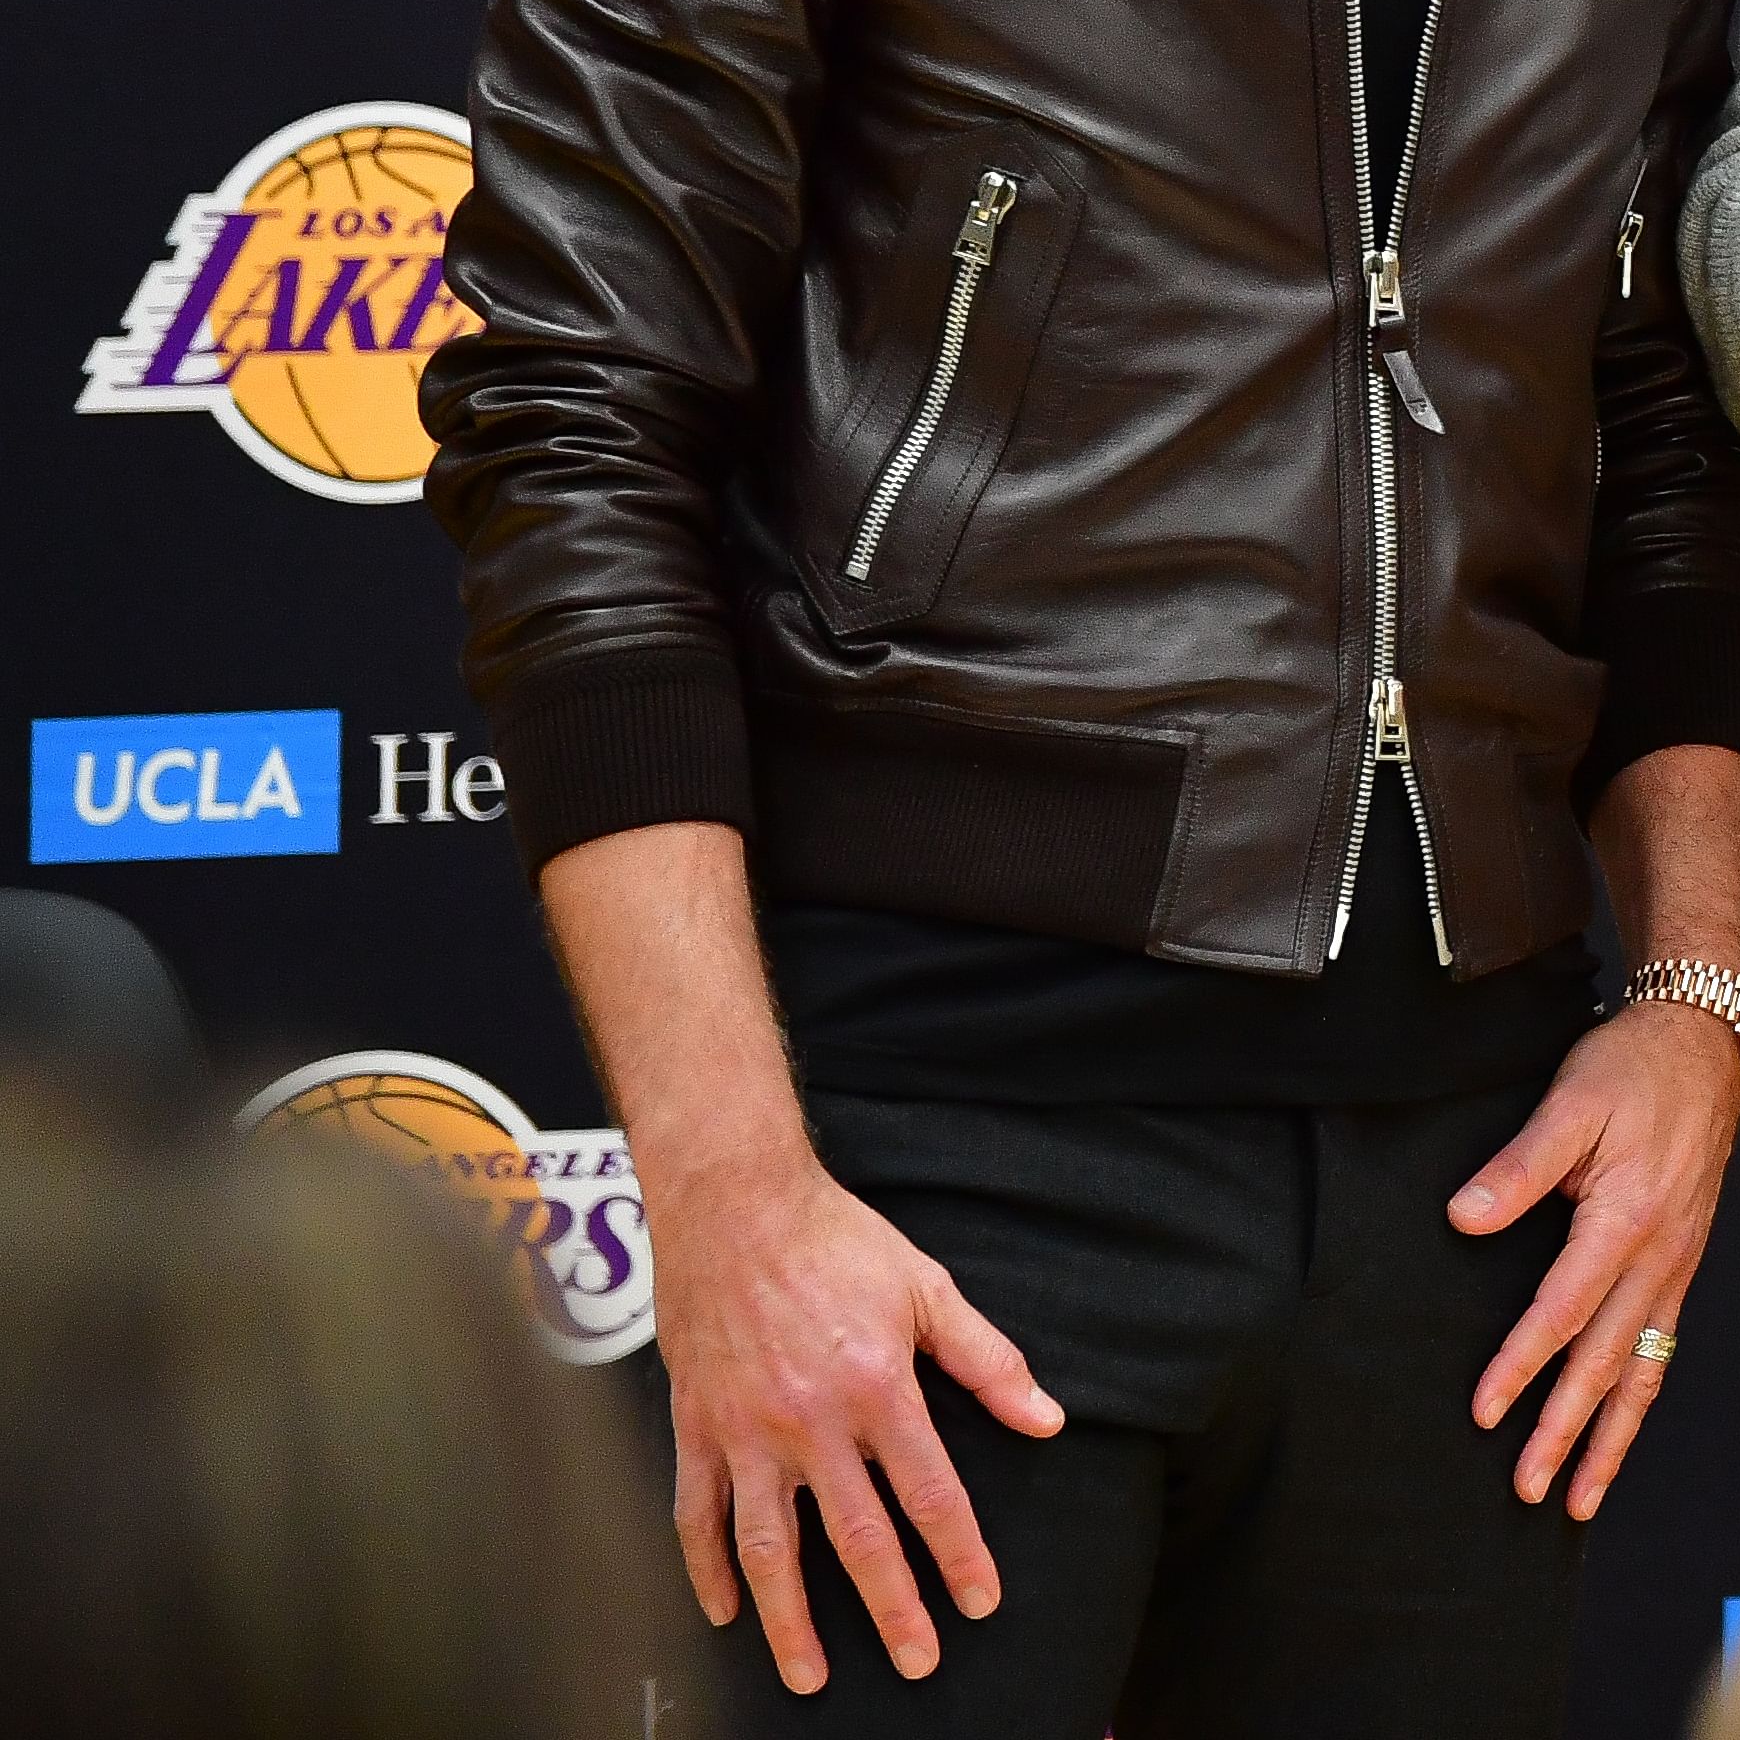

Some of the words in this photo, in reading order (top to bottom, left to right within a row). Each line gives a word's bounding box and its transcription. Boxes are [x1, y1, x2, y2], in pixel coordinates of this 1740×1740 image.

[299, 207, 396, 238] LOS
[111, 210, 468, 389] LAKE
[73, 746, 301, 827] UCLA
